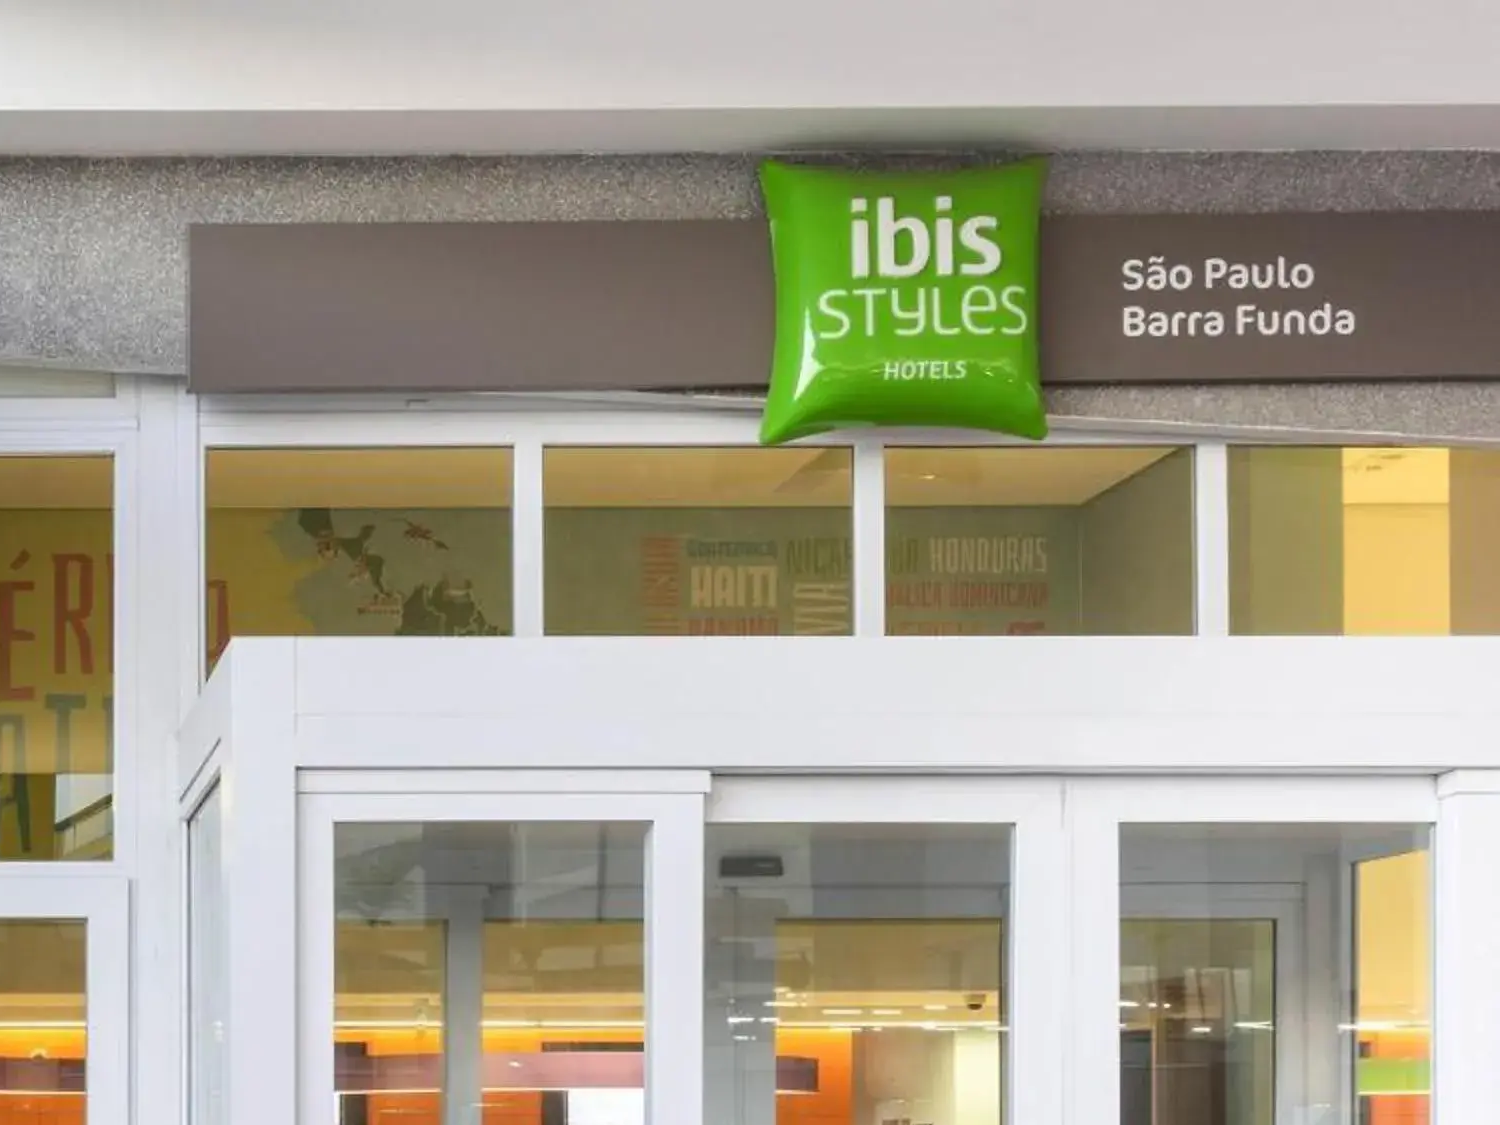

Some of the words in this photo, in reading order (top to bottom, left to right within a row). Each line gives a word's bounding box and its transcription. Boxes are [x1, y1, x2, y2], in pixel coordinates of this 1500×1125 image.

[850, 196, 1001, 278] ibis
[1122, 258, 1192, 291] São
[1205, 257, 1315, 289] Paulo
[1123, 308, 1224, 337] Barra
[1237, 304, 1356, 336] Funda
[885, 361, 965, 379] HOTELS
[930, 536, 1047, 573] HONDURAS
[690, 565, 778, 608] HAITI
